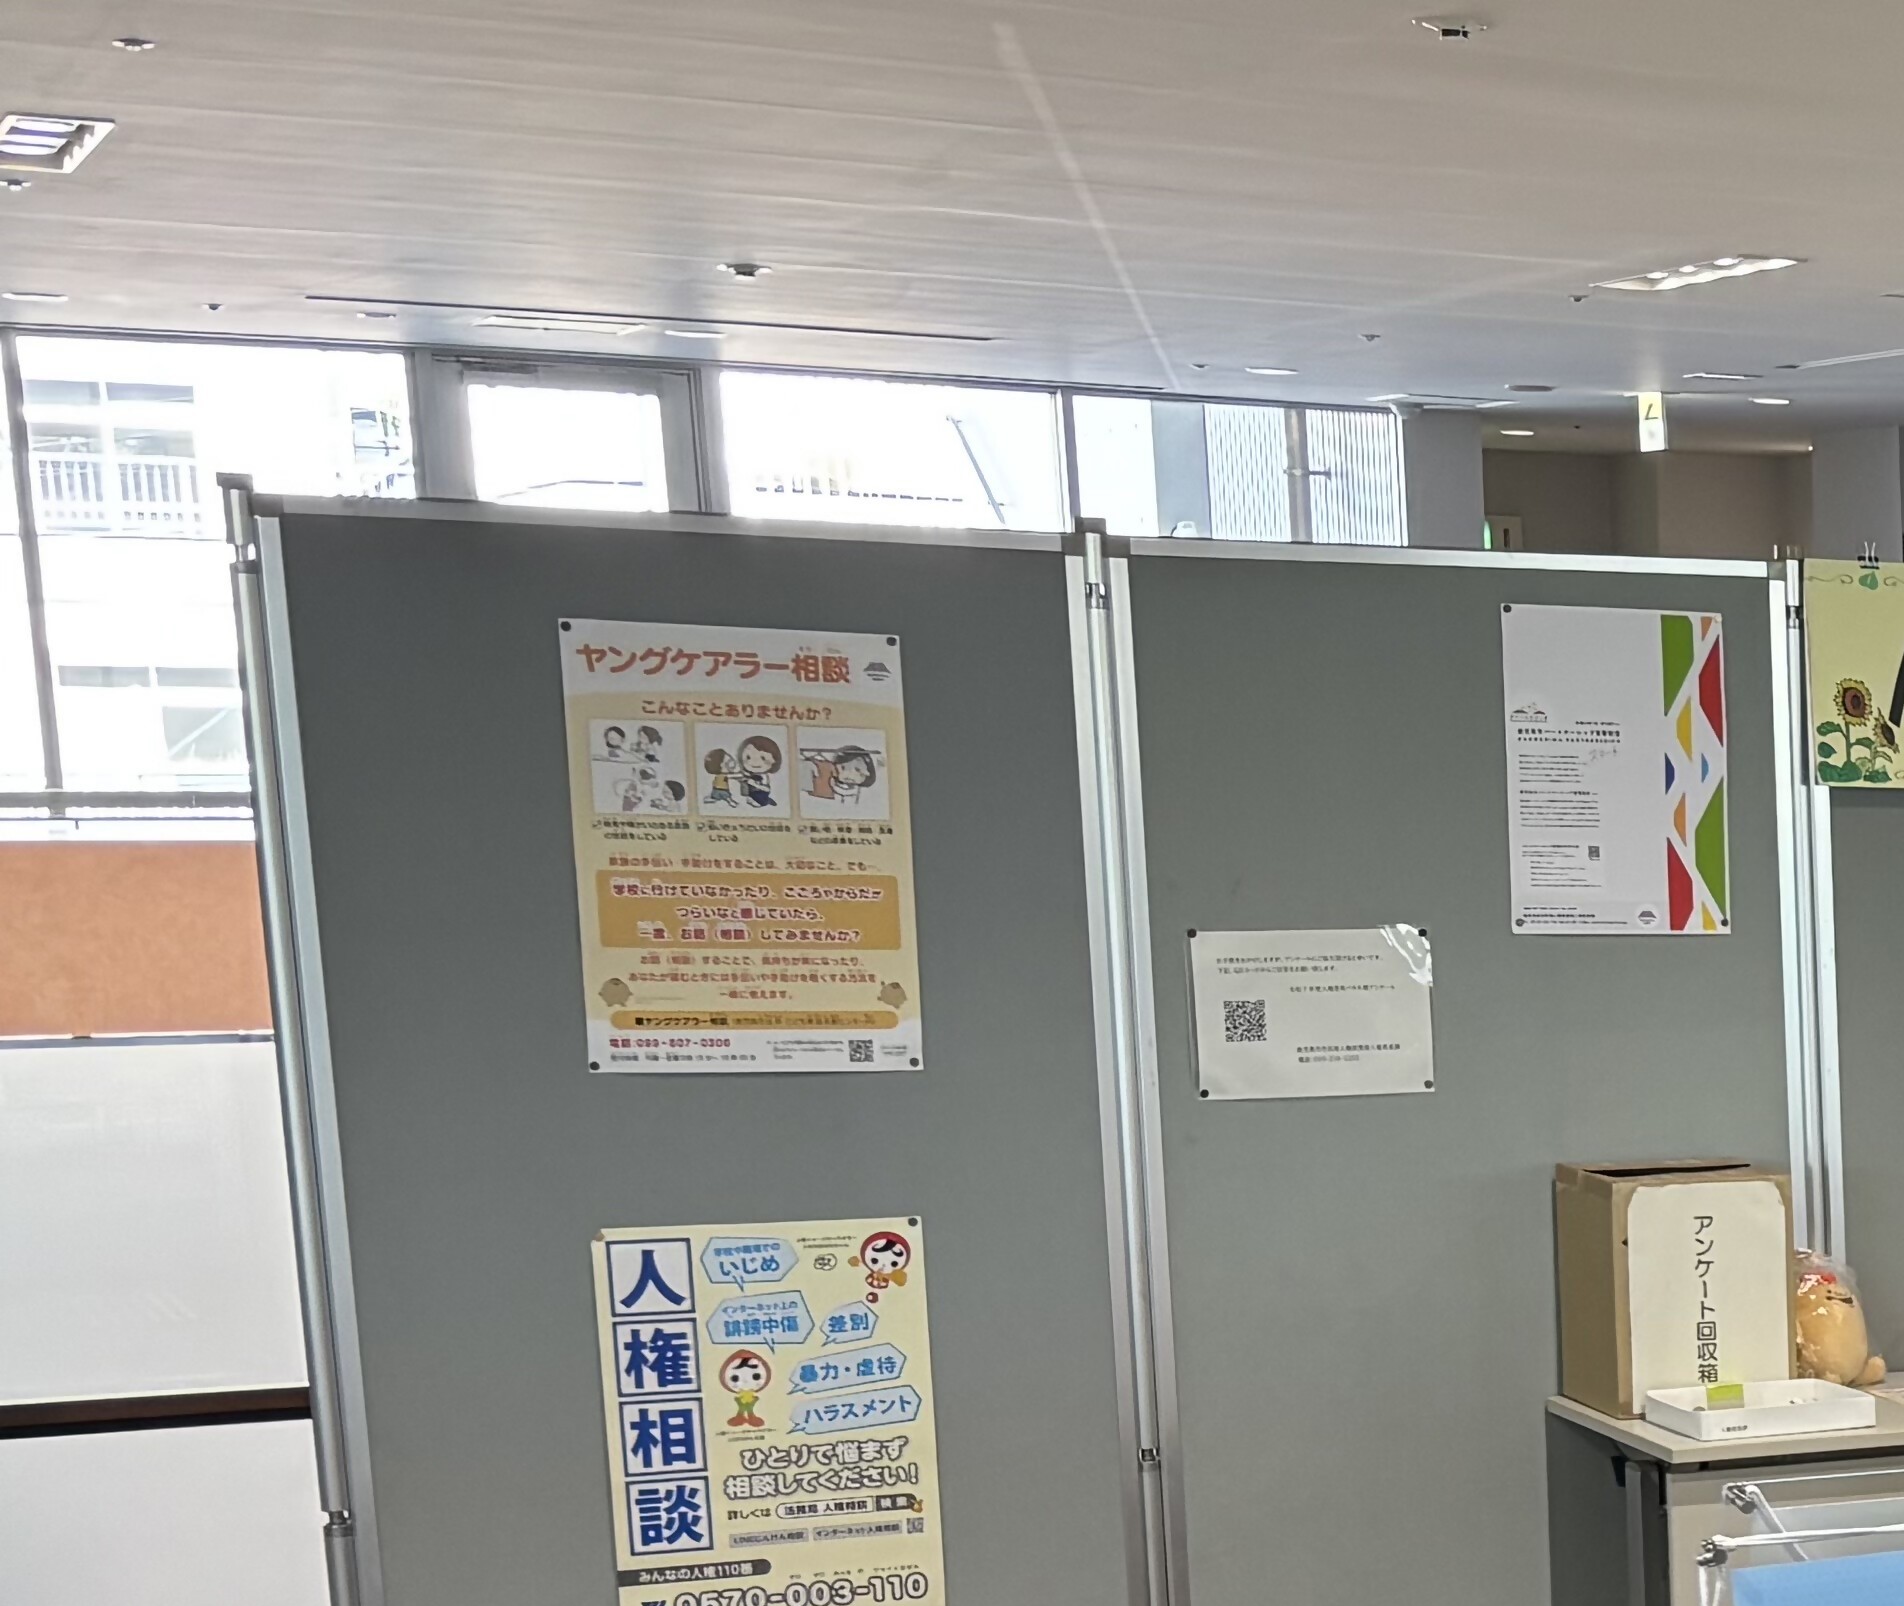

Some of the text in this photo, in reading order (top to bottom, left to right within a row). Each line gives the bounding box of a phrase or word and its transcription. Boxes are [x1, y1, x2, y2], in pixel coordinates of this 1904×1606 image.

[576, 643, 852, 685] ヤングケアラー相談
[642, 701, 832, 721] こんなことありませんか？
[719, 1256, 780, 1277] いじめ
[1693, 1215, 1718, 1382] アンケート回収箱
[829, 1312, 869, 1332] 差別
[799, 1356, 895, 1383] 暴力・虐待
[619, 1249, 704, 1547] 人権相談
[804, 1397, 912, 1424] ハラスメント
[741, 1437, 907, 1470] ひとりで悩まず
[724, 1462, 919, 1499] 相談してください！
[727, 1507, 771, 1521] 詳しくは
